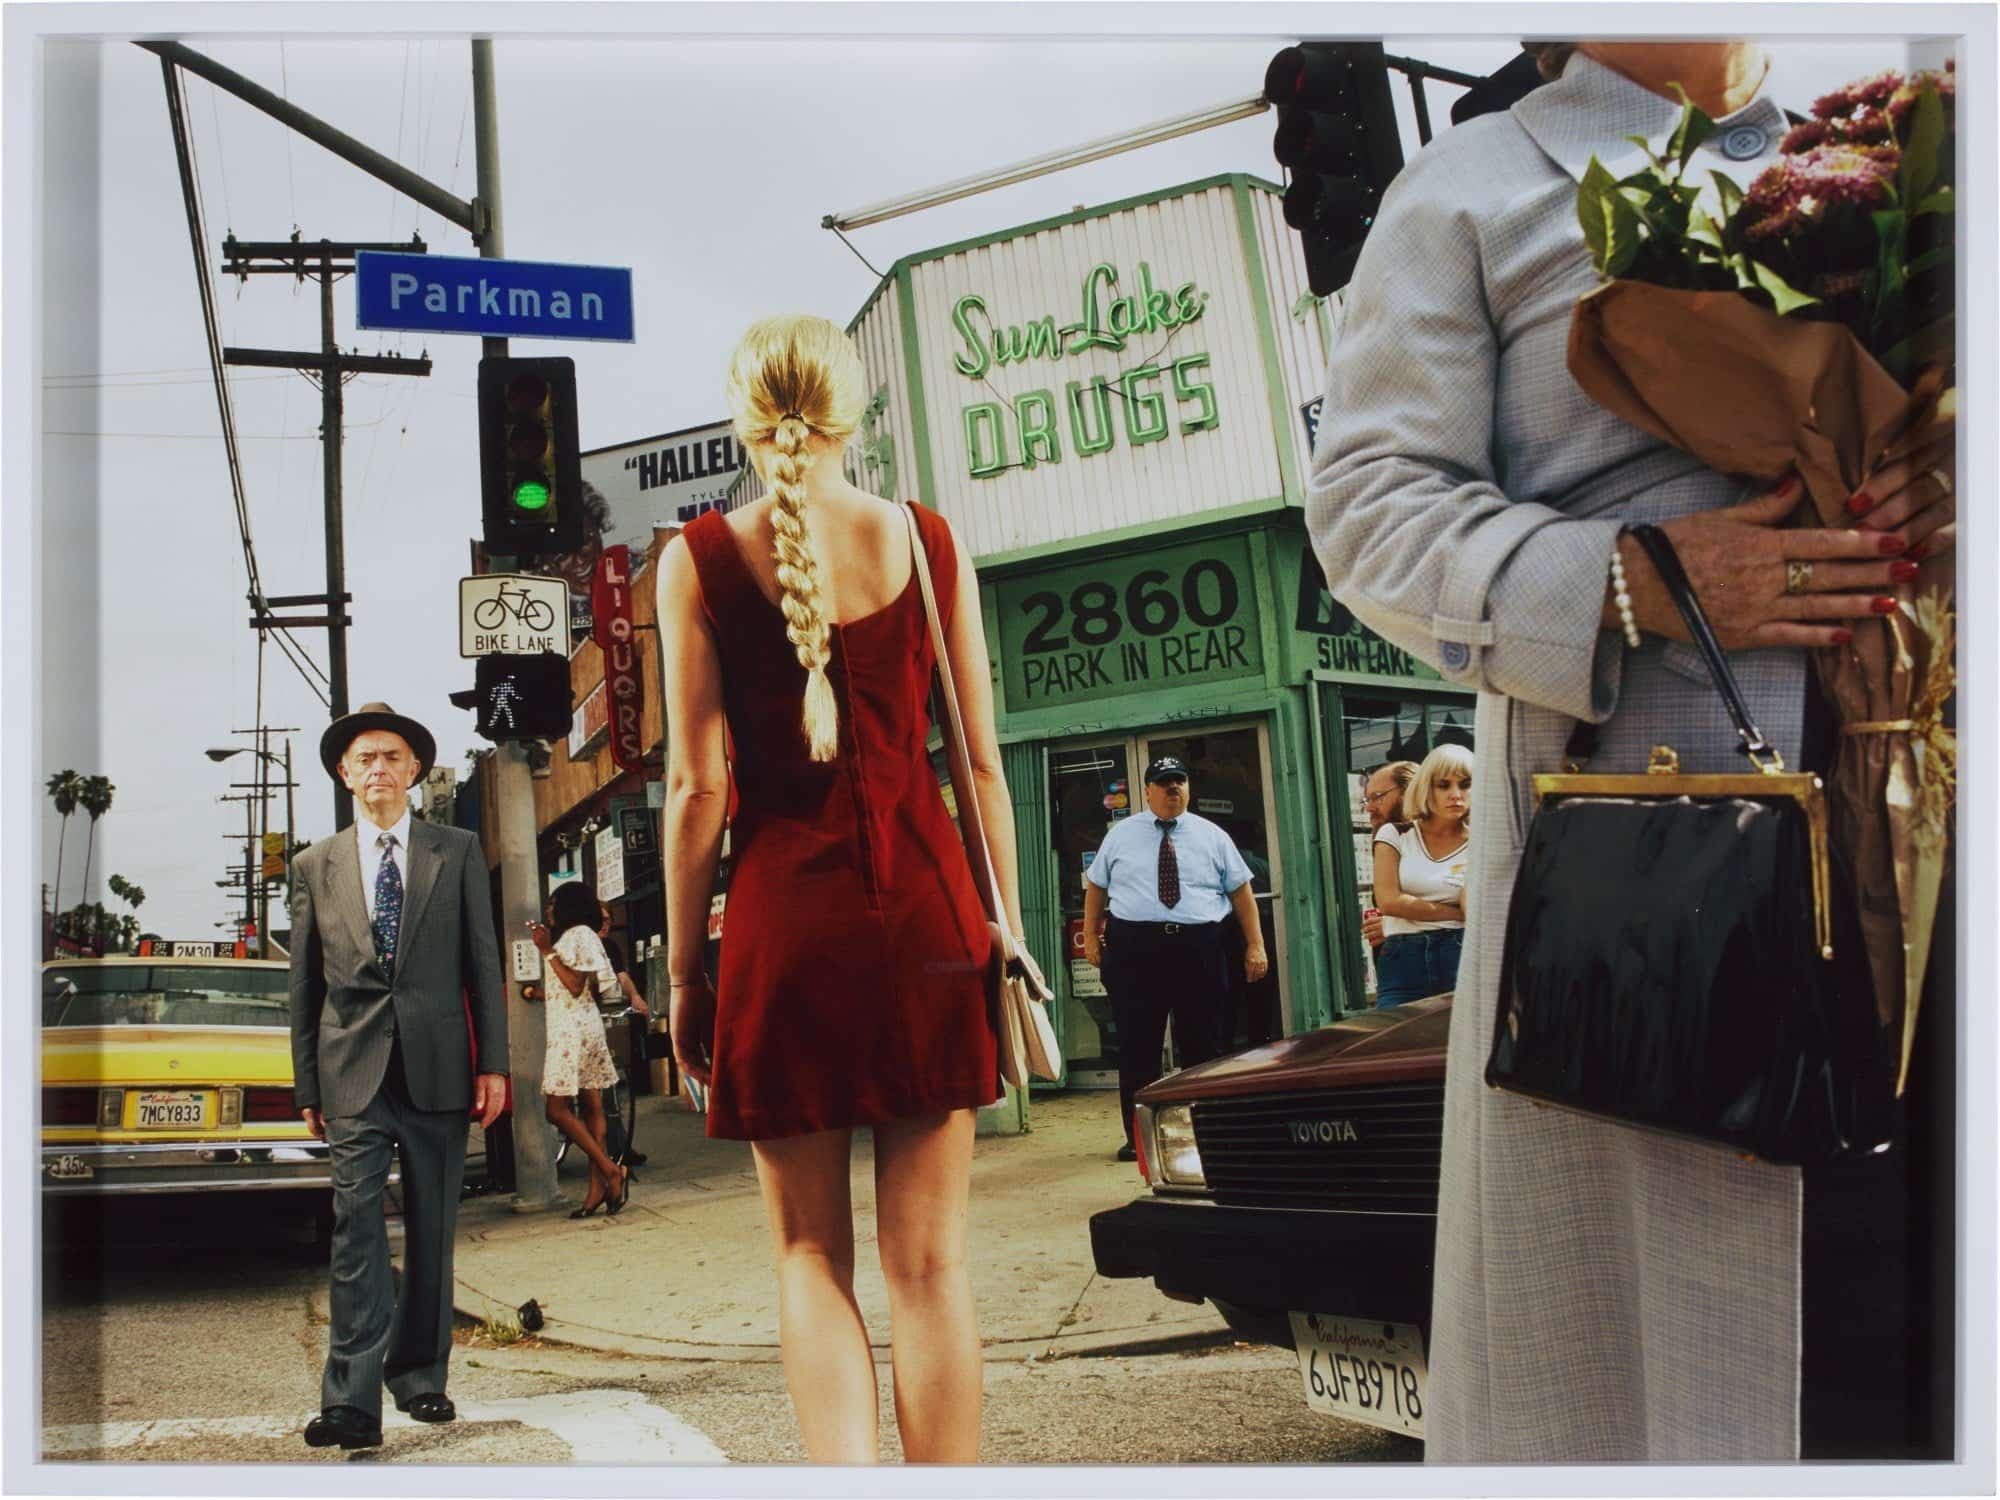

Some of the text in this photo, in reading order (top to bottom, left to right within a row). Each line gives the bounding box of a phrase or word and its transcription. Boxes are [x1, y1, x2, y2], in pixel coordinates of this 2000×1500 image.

[390, 272, 604, 321] Parkman
[963, 352, 1219, 479] DRUGS
[1021, 559, 1239, 657] 2860
[475, 634, 554, 652] BIKE LANE
[606, 557, 641, 760] LIQUORS
[1023, 625, 1249, 699] PARK IN REAR
[139, 1104, 201, 1123] 7MCY833
[1289, 1121, 1358, 1143] TOYOTA
[1314, 1319, 1388, 1353] California
[1310, 1348, 1422, 1420] 6JFB978
